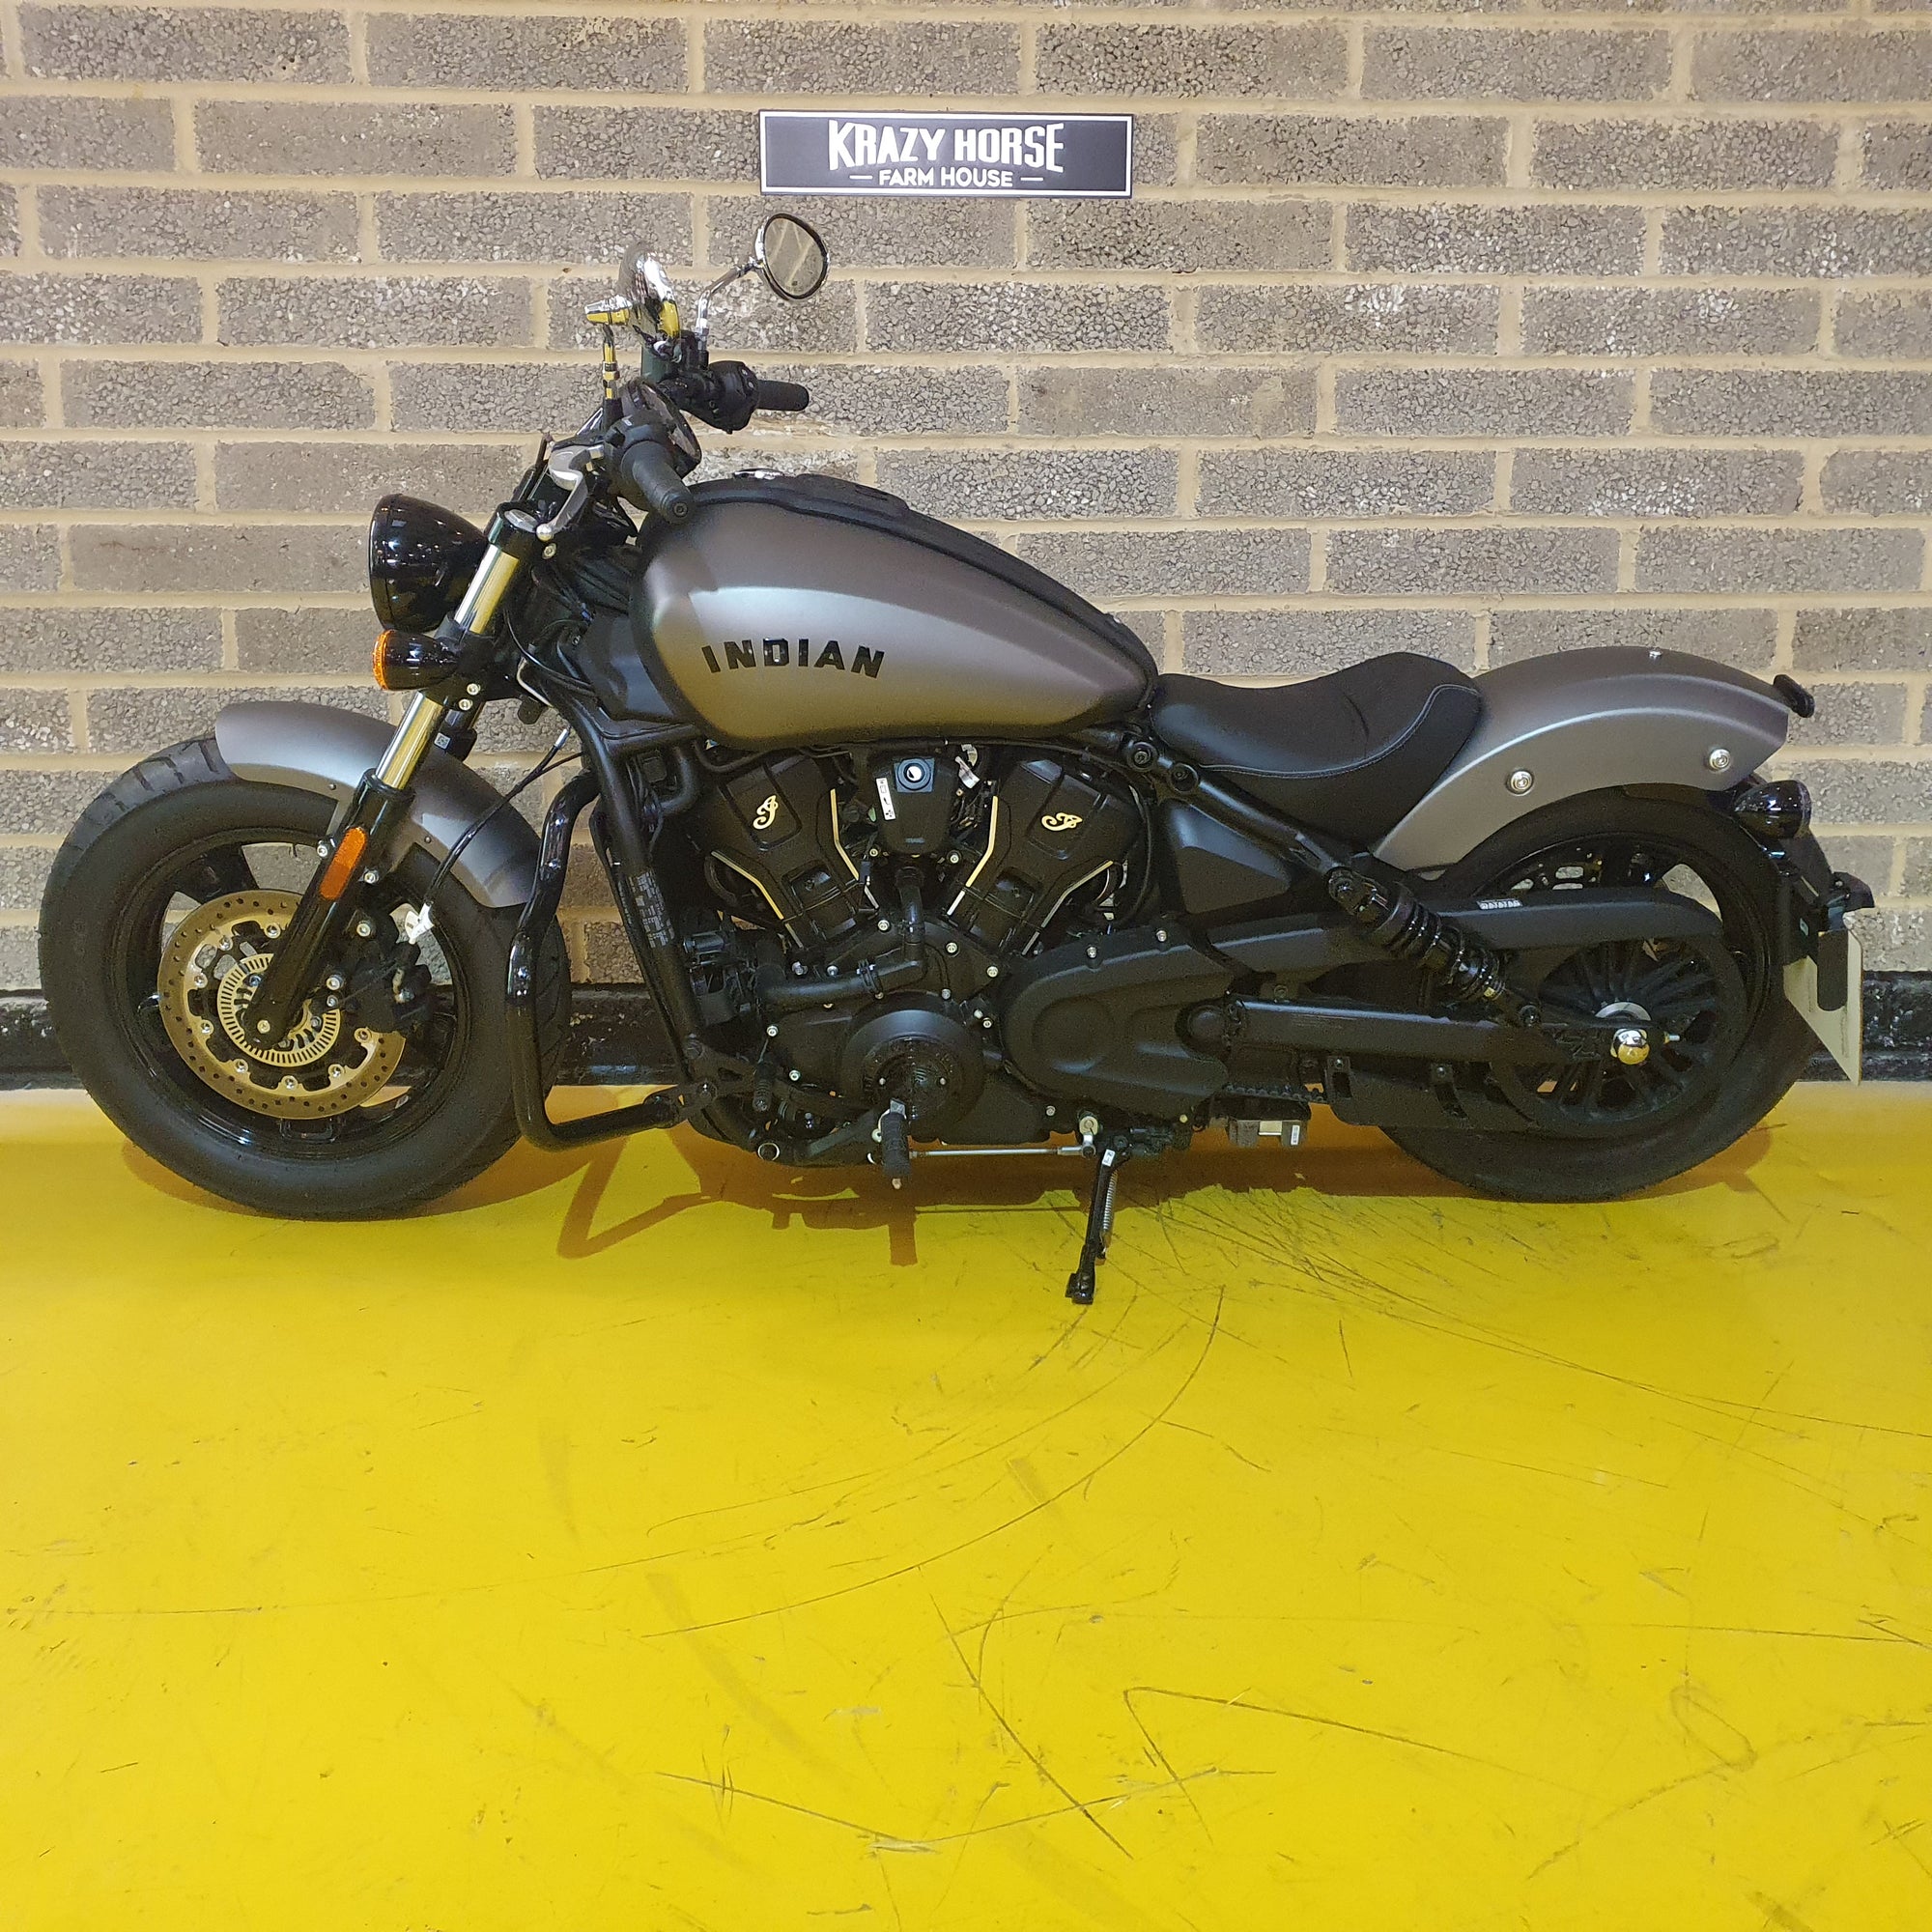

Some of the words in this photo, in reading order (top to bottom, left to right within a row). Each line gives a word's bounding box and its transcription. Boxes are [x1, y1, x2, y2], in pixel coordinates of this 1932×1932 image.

[828, 119, 946, 171] KRAZY
[953, 123, 1065, 173] HORSE
[878, 166, 934, 186] FARM
[940, 166, 1013, 187] HOUSE
[700, 637, 886, 679] INDIAN
